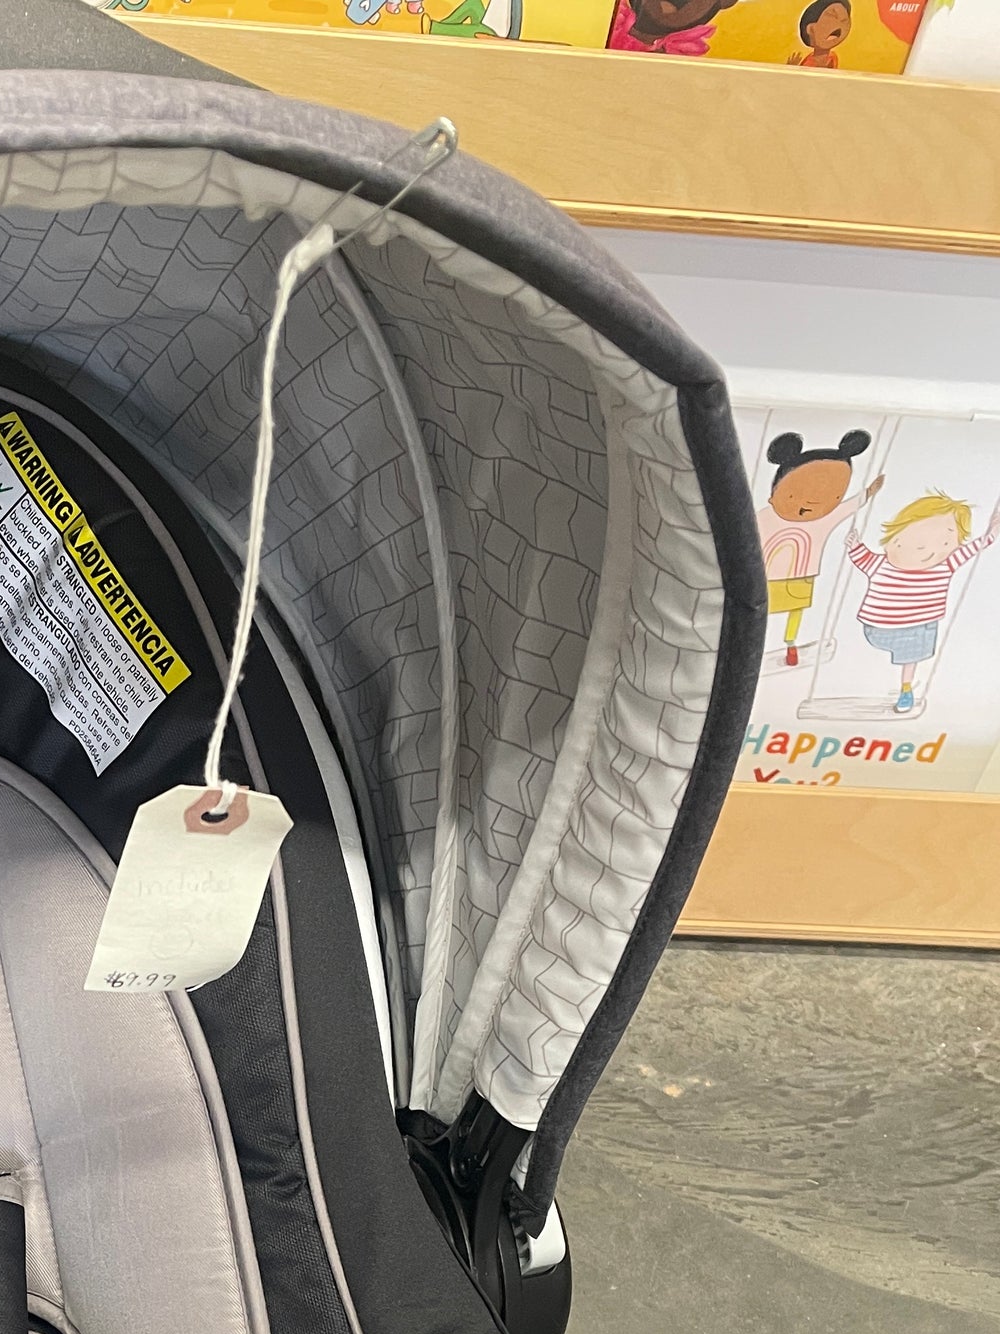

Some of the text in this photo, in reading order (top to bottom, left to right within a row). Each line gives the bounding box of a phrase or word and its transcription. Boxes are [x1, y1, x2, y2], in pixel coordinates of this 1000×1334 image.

[889, 3, 920, 12] ABOUT
[0, 523, 17, 547] even
[16, 544, 38, 573] when
[46, 595, 54, 607] is
[53, 605, 74, 630] used
[90, 661, 103, 680] the
[101, 677, 130, 716] vehicle.
[6, 429, 174, 677] WARNING ADVERTENCIA
[9, 509, 41, 550] buckled
[87, 631, 113, 668] restrain
[112, 665, 125, 684] the
[123, 682, 144, 708] child
[19, 497, 160, 703] Children STRANGLED in loose or partially
[8, 564, 21, 578] se
[27, 591, 81, 671] ESTRANGULADO
[77, 671, 92, 690] con
[91, 689, 120, 726] correas
[119, 724, 133, 741] del
[14, 626, 22, 636] al
[87, 723, 102, 742] use
[101, 741, 109, 752] el
[18, 652, 34, 668] del
[743, 724, 947, 767] Happened
